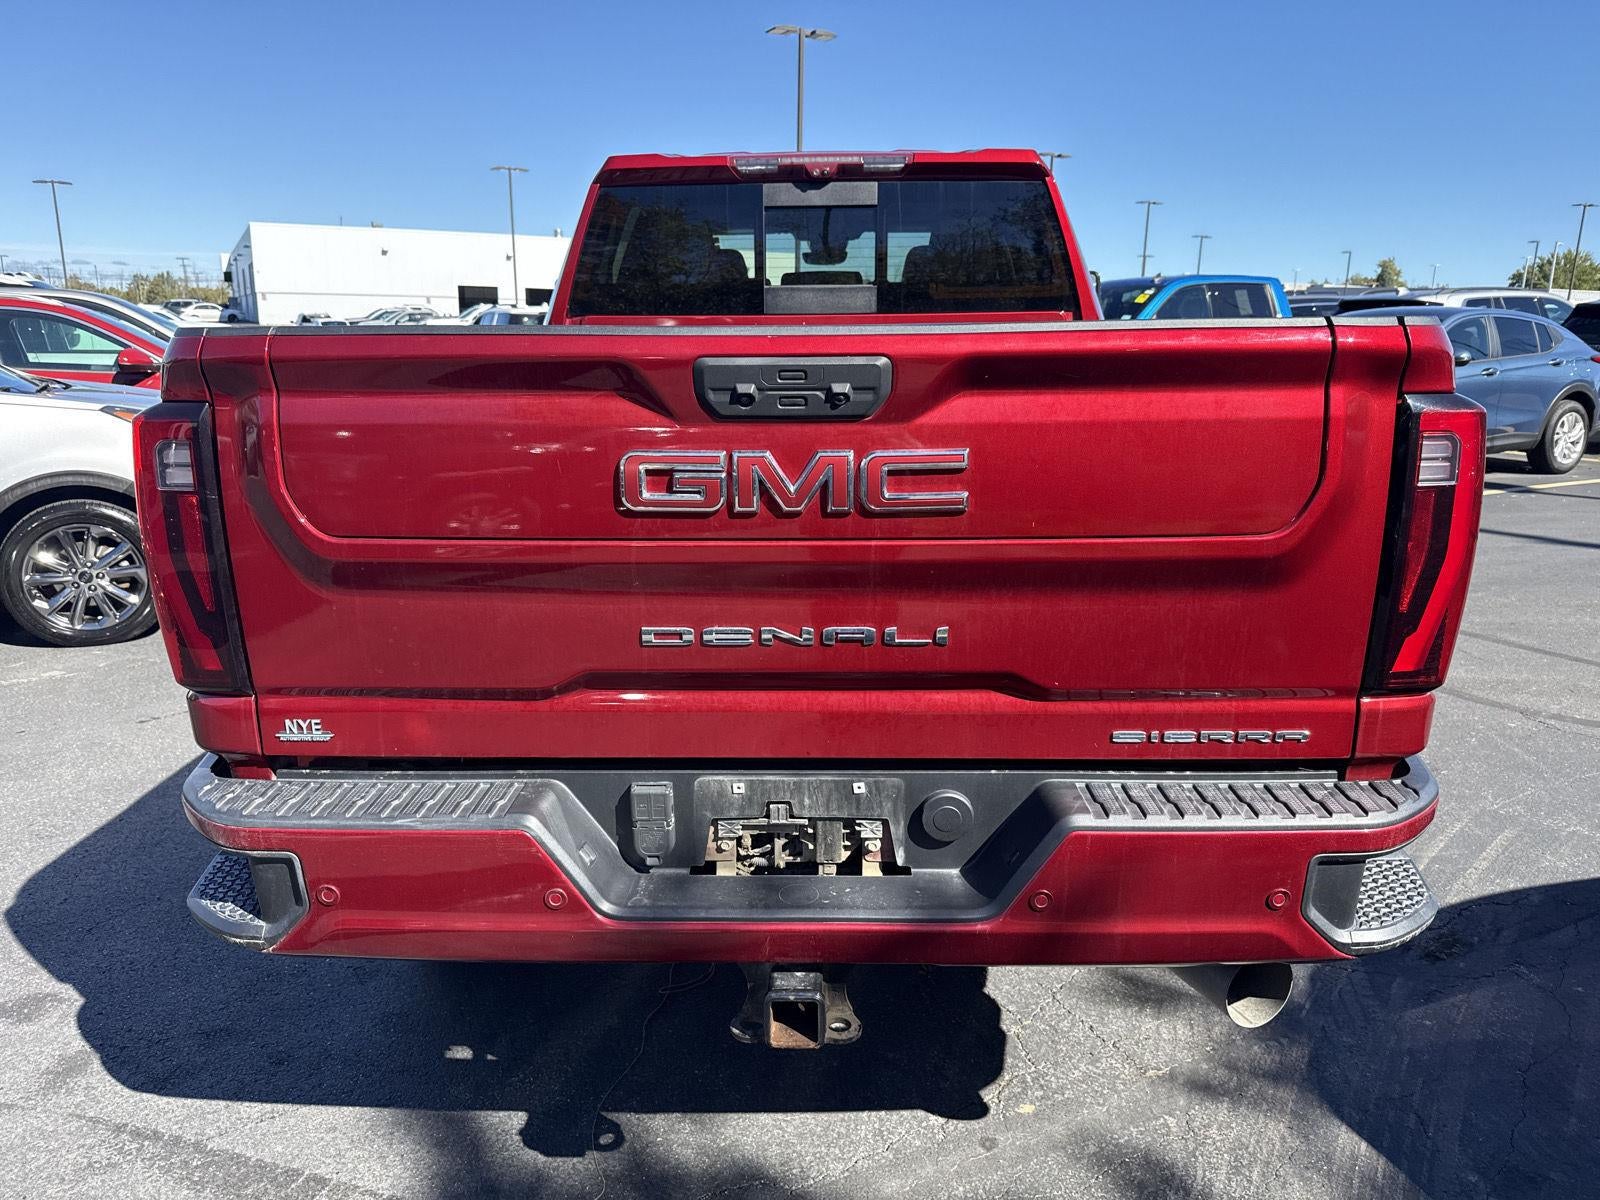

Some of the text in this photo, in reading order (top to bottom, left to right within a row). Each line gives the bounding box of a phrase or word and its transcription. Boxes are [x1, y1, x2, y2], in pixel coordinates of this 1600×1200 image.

[619, 448, 970, 513] GMC
[640, 626, 949, 646] DENALI
[284, 718, 322, 734] NYE
[1111, 730, 1311, 743] SIERRA
